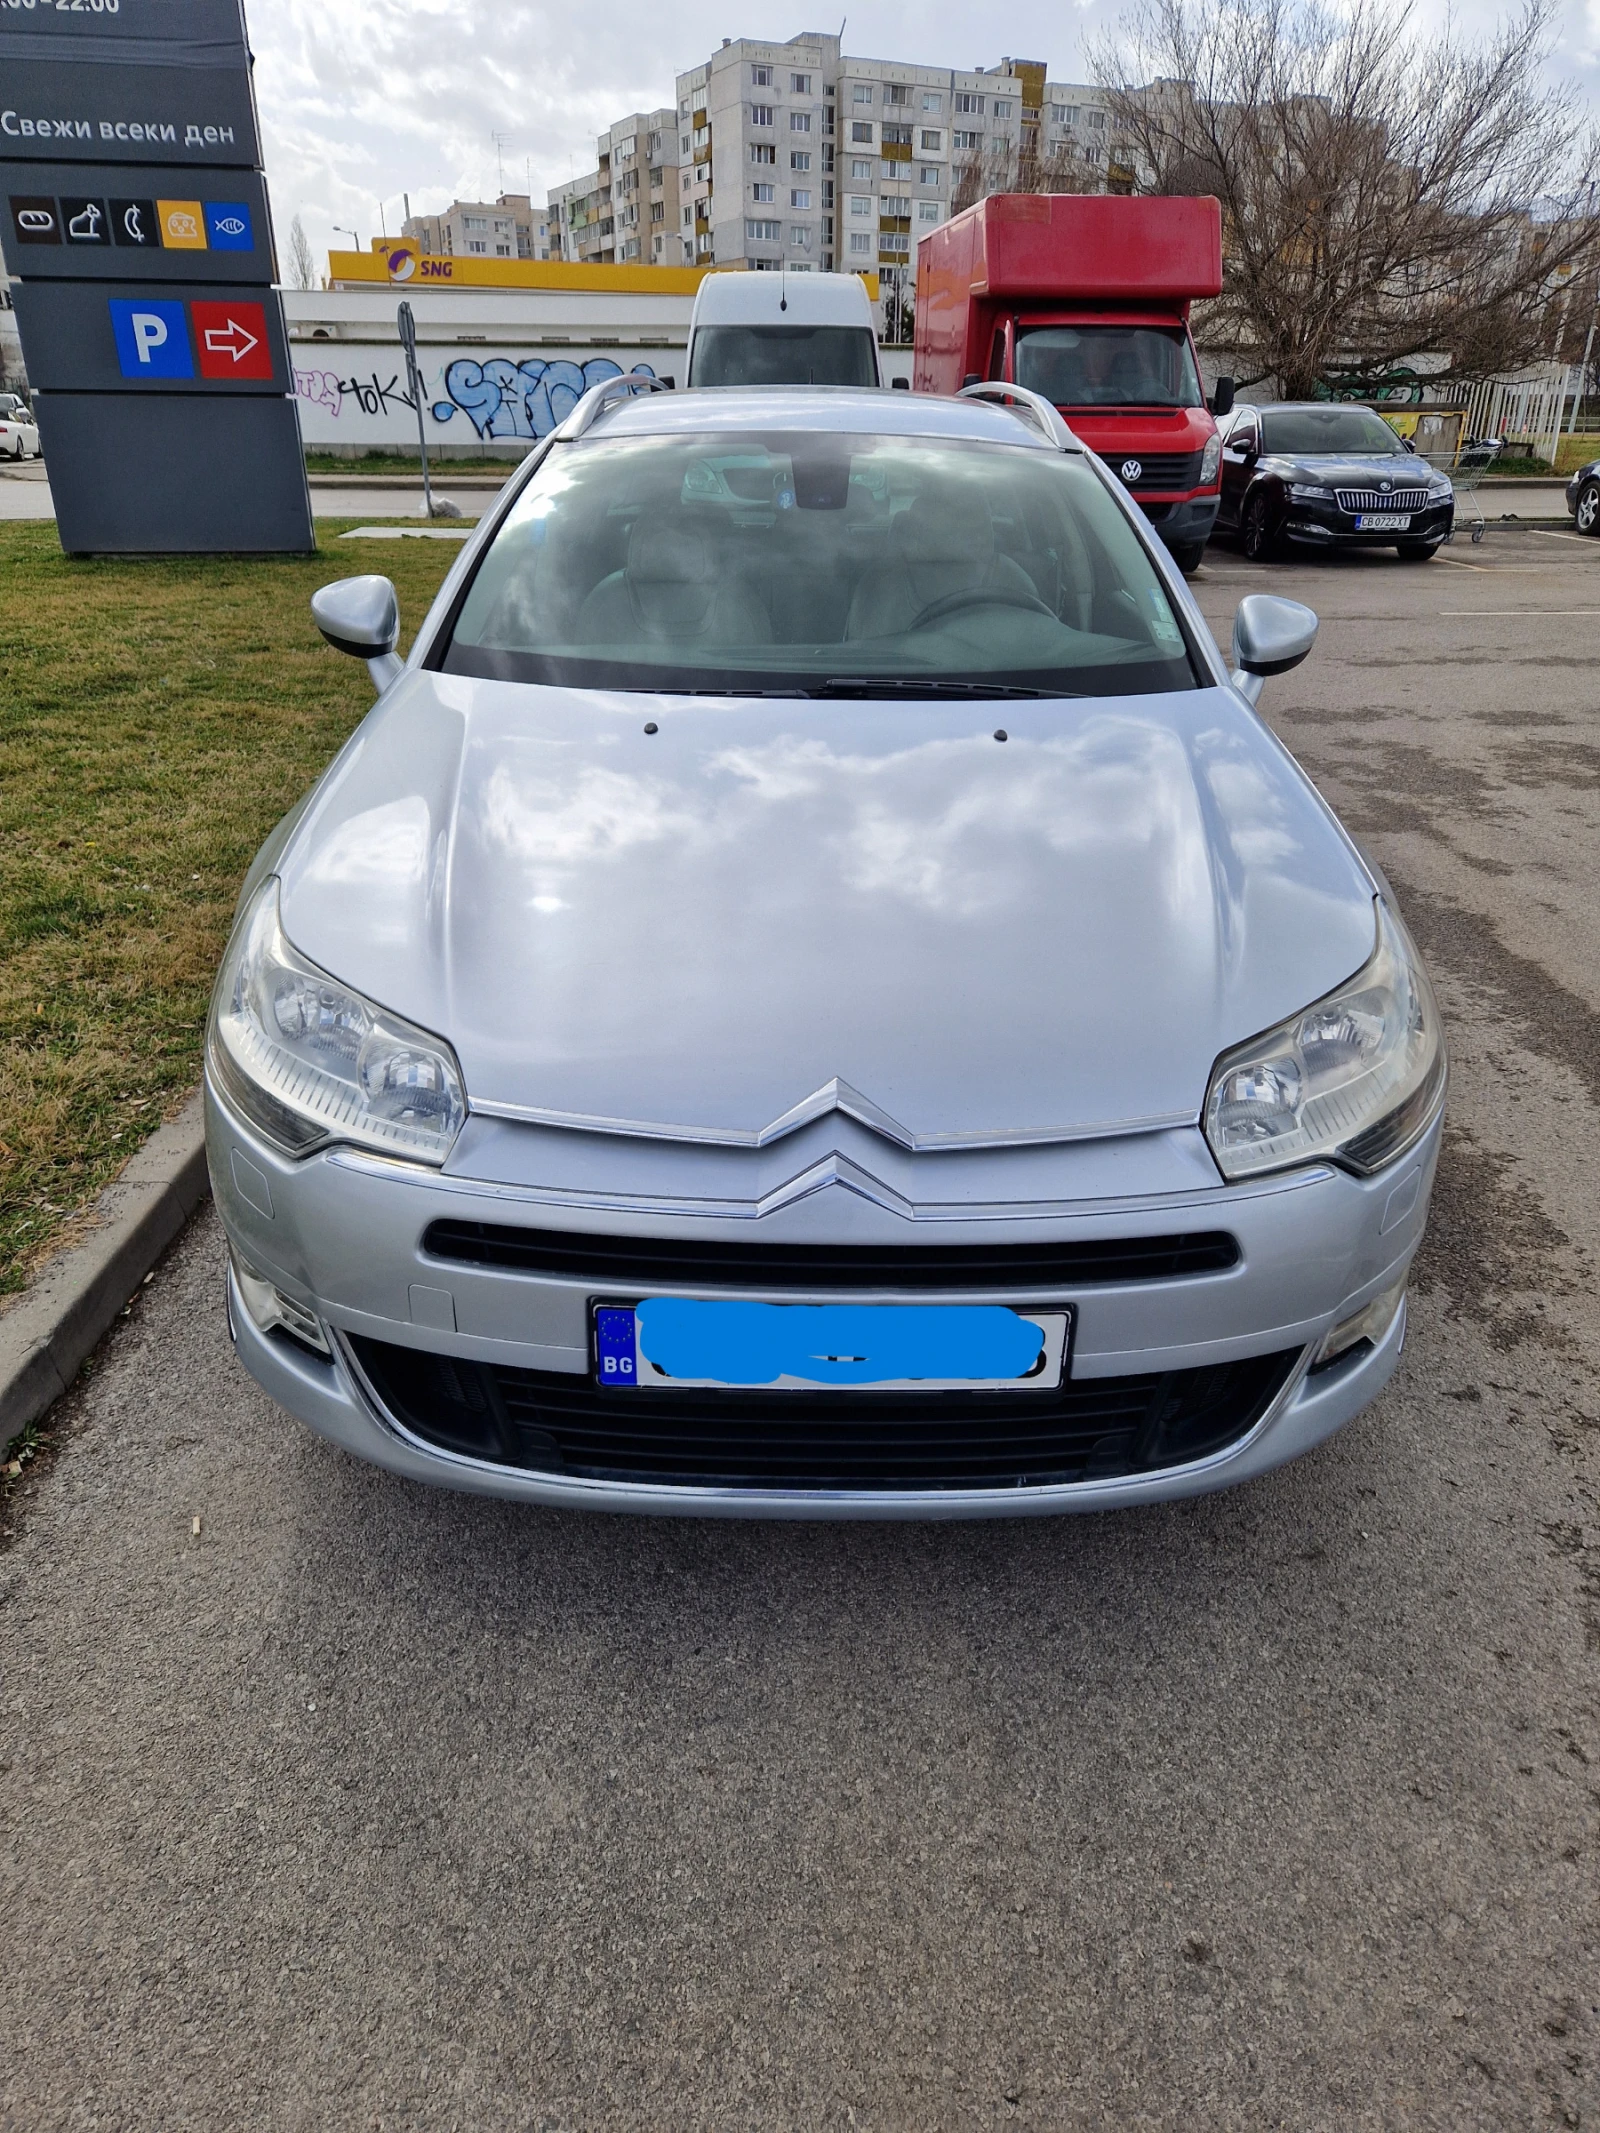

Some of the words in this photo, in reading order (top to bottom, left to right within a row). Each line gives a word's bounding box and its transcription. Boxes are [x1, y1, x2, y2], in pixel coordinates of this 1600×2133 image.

[0, 110, 92, 139] Свежи
[99, 120, 177, 143] всеки
[184, 124, 235, 148] ден
[420, 260, 453, 277] SNG
[131, 313, 168, 363] P
[1362, 517, 1374, 526] CB
[1375, 517, 1397, 526] 0722
[603, 1356, 633, 1374] BG
